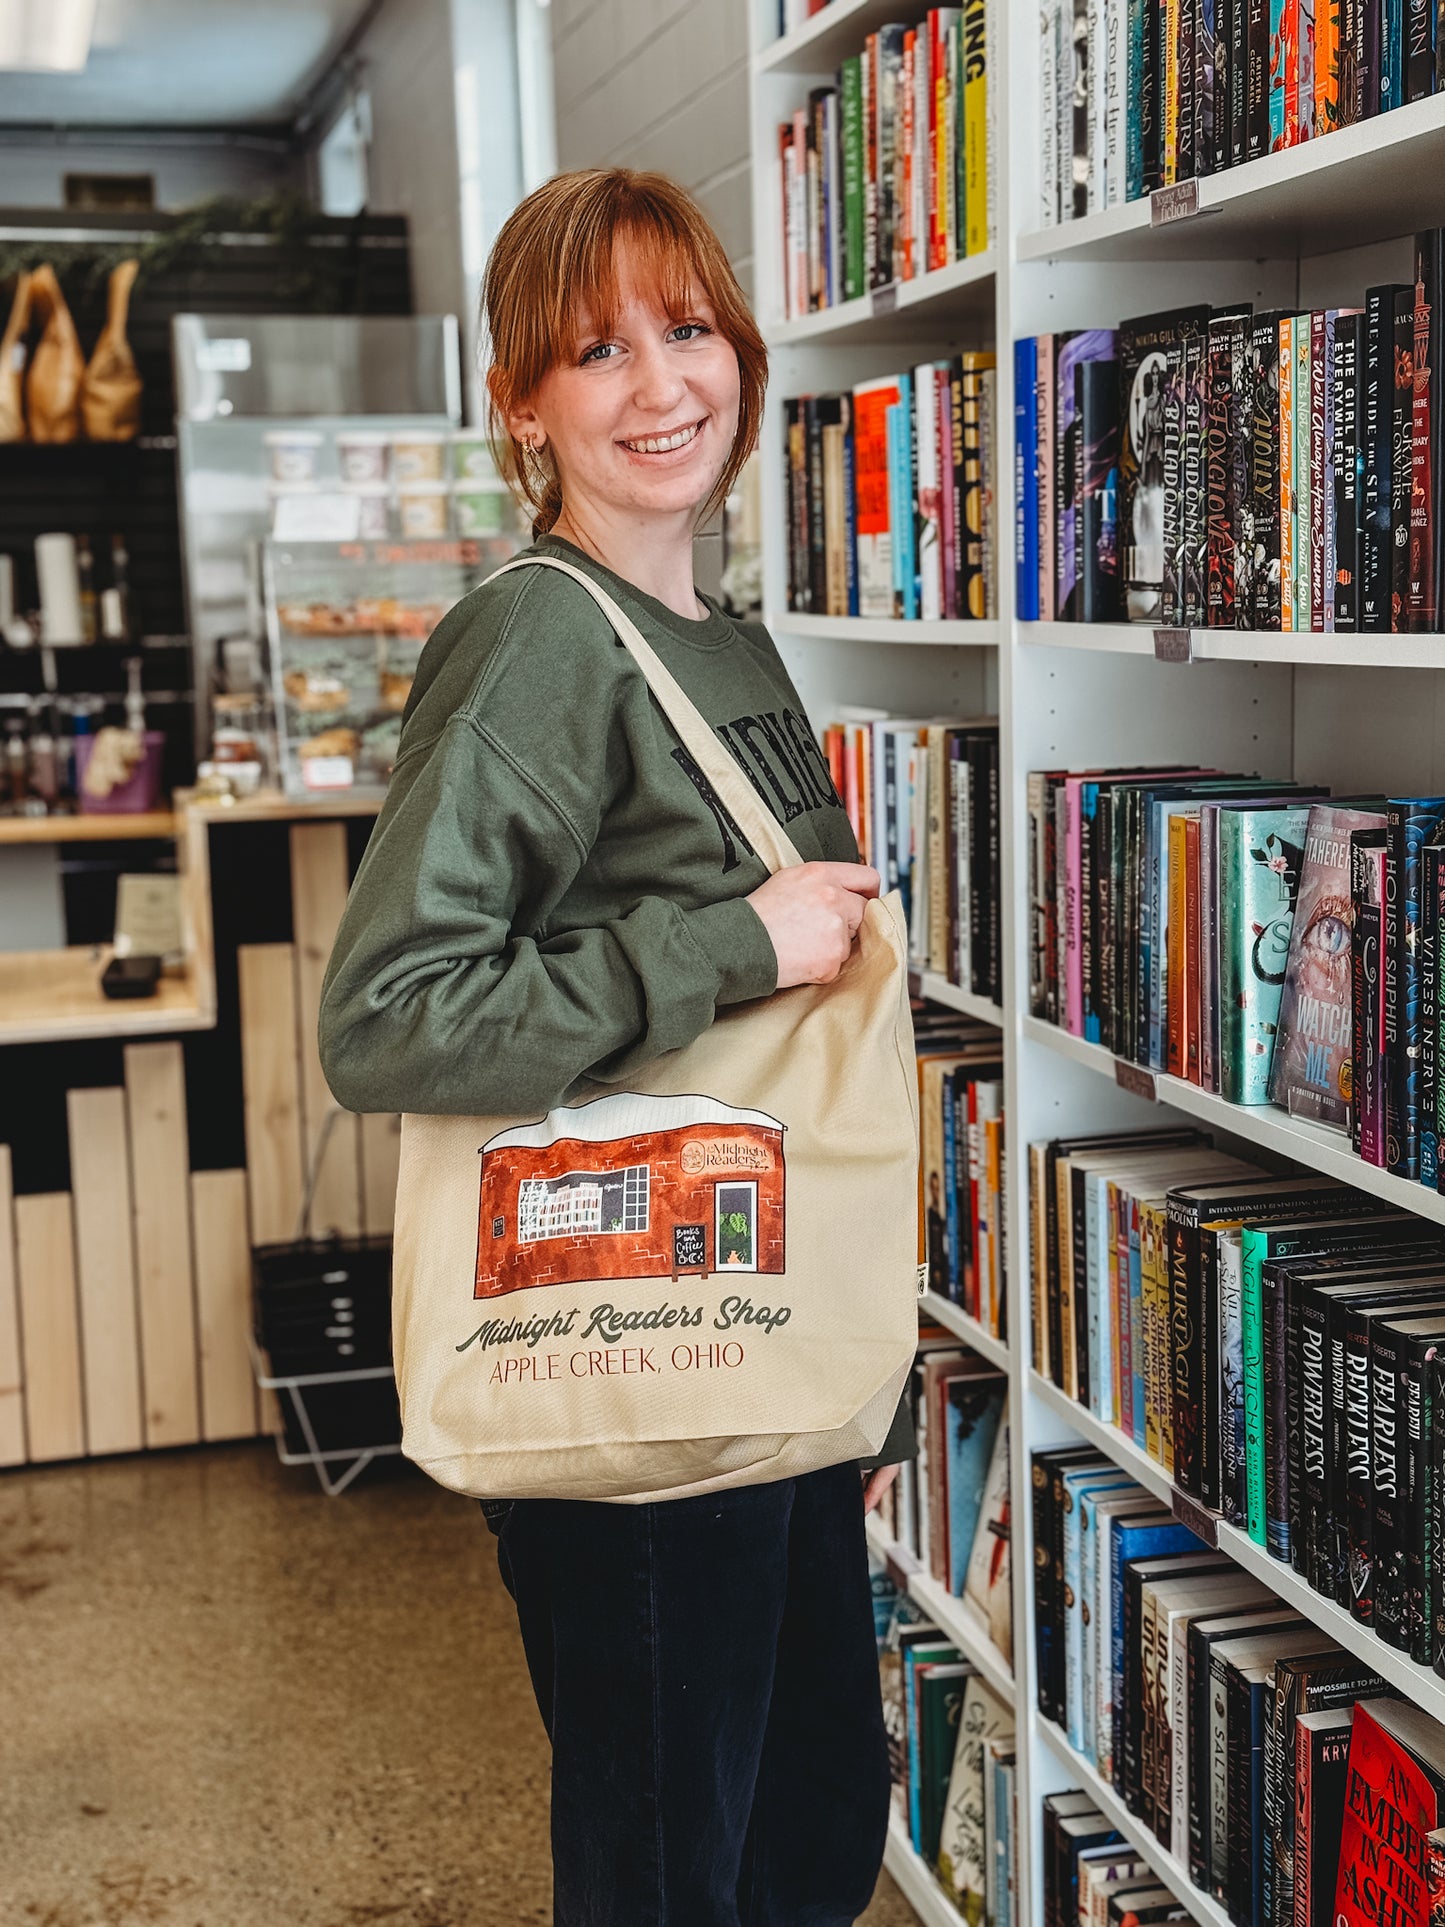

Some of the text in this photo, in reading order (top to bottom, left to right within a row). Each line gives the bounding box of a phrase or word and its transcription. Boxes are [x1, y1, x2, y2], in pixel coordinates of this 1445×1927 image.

[1108, 18, 1120, 156] STOLEN HEIR
[1142, 74, 1152, 135] WIND
[1181, 44, 1191, 156] AND FURY
[1156, 184, 1194, 206] Young Adult
[1159, 201, 1188, 222] fiction
[1135, 331, 1176, 346] NIKITA GILL
[1368, 296, 1380, 368] BREAK
[1325, 381, 1334, 424] Mate
[1334, 342, 1344, 477] EVERYWHERE
[1344, 339, 1355, 500] THE GIRL FROM
[1367, 380, 1378, 436] WIDE
[1414, 418, 1424, 428] THE
[1184, 397, 1201, 564] BELLADONNA
[1208, 399, 1234, 552] FOXGLOVE
[1254, 388, 1273, 500] HOLLY
[1392, 409, 1402, 511] FLOWERS
[1402, 422, 1413, 496] GRAVE
[1161, 399, 1180, 564] BELLADONNA
[1279, 378, 1292, 607] The Summer I Turned Pretty
[1297, 402, 1312, 610] Not Summer Without You
[1311, 359, 1324, 608] We'll Always Have Summer
[1365, 473, 1378, 521] SEA
[1325, 480, 1334, 590] ALI HAZELWOOD
[1082, 821, 1091, 994] ALL THE LOST SOULS
[1139, 857, 1146, 892] we
[1152, 856, 1159, 886] we
[1386, 859, 1397, 946] HOUSE
[1066, 886, 1075, 951] SCAMMER
[1098, 878, 1110, 1005] DEFY NIGHT
[1139, 902, 1150, 945] fell
[1362, 913, 1379, 923] MEYER
[1151, 953, 1160, 998] liars
[1354, 955, 1363, 1016] NOTHING
[1386, 956, 1397, 1044] SAPHIR
[1296, 994, 1351, 1048] WATCH
[1355, 1021, 1363, 1063] MORE
[1422, 935, 1434, 1113] WIRES NERVE
[1305, 1041, 1334, 1089] ME
[706, 1154, 757, 1167] Readers
[713, 1143, 768, 1158] Midnight
[676, 1227, 700, 1238] Books
[677, 1242, 703, 1254] Coffee
[1167, 1210, 1199, 1229] PAOLINI
[455, 1295, 792, 1352] Midnight Readers Shop
[1120, 1256, 1129, 1336] BETTING
[1173, 1250, 1192, 1400] MURTAGH
[1227, 1286, 1239, 1321] KILL
[489, 1342, 744, 1385] APPLE CREEK, OHIO
[1122, 1340, 1130, 1370] ON
[1142, 1306, 1152, 1407] THE MOVIES
[1149, 1301, 1159, 1416] NOTHING LIKE
[1243, 1245, 1261, 1430] NIGHT WITCH
[1123, 1375, 1133, 1413] YOU
[1159, 1353, 1167, 1416] MOVIES
[1263, 1319, 1276, 1516] THEORY DREAMING
[1302, 1325, 1325, 1480] POWERLESS
[1346, 1351, 1370, 1480] RECKLESS
[1227, 1395, 1235, 1479] KATHERINE
[1373, 1363, 1397, 1498] FEARLESS
[1431, 1464, 1442, 1574] AND BONE
[1111, 1529, 1125, 1710] Down Comes The Night
[1357, 1679, 1368, 1688] TO
[1175, 1654, 1184, 1808] THIS SAVAGE SONG
[1275, 1689, 1286, 1842] Our Infinite Fates
[1214, 1726, 1226, 1848] SALT SEA
[1386, 1762, 1411, 1812] AN
[1263, 1829, 1272, 1919] JULIE SOTO
[1360, 1832, 1379, 1875] IN
[1385, 1854, 1421, 1915] THE
